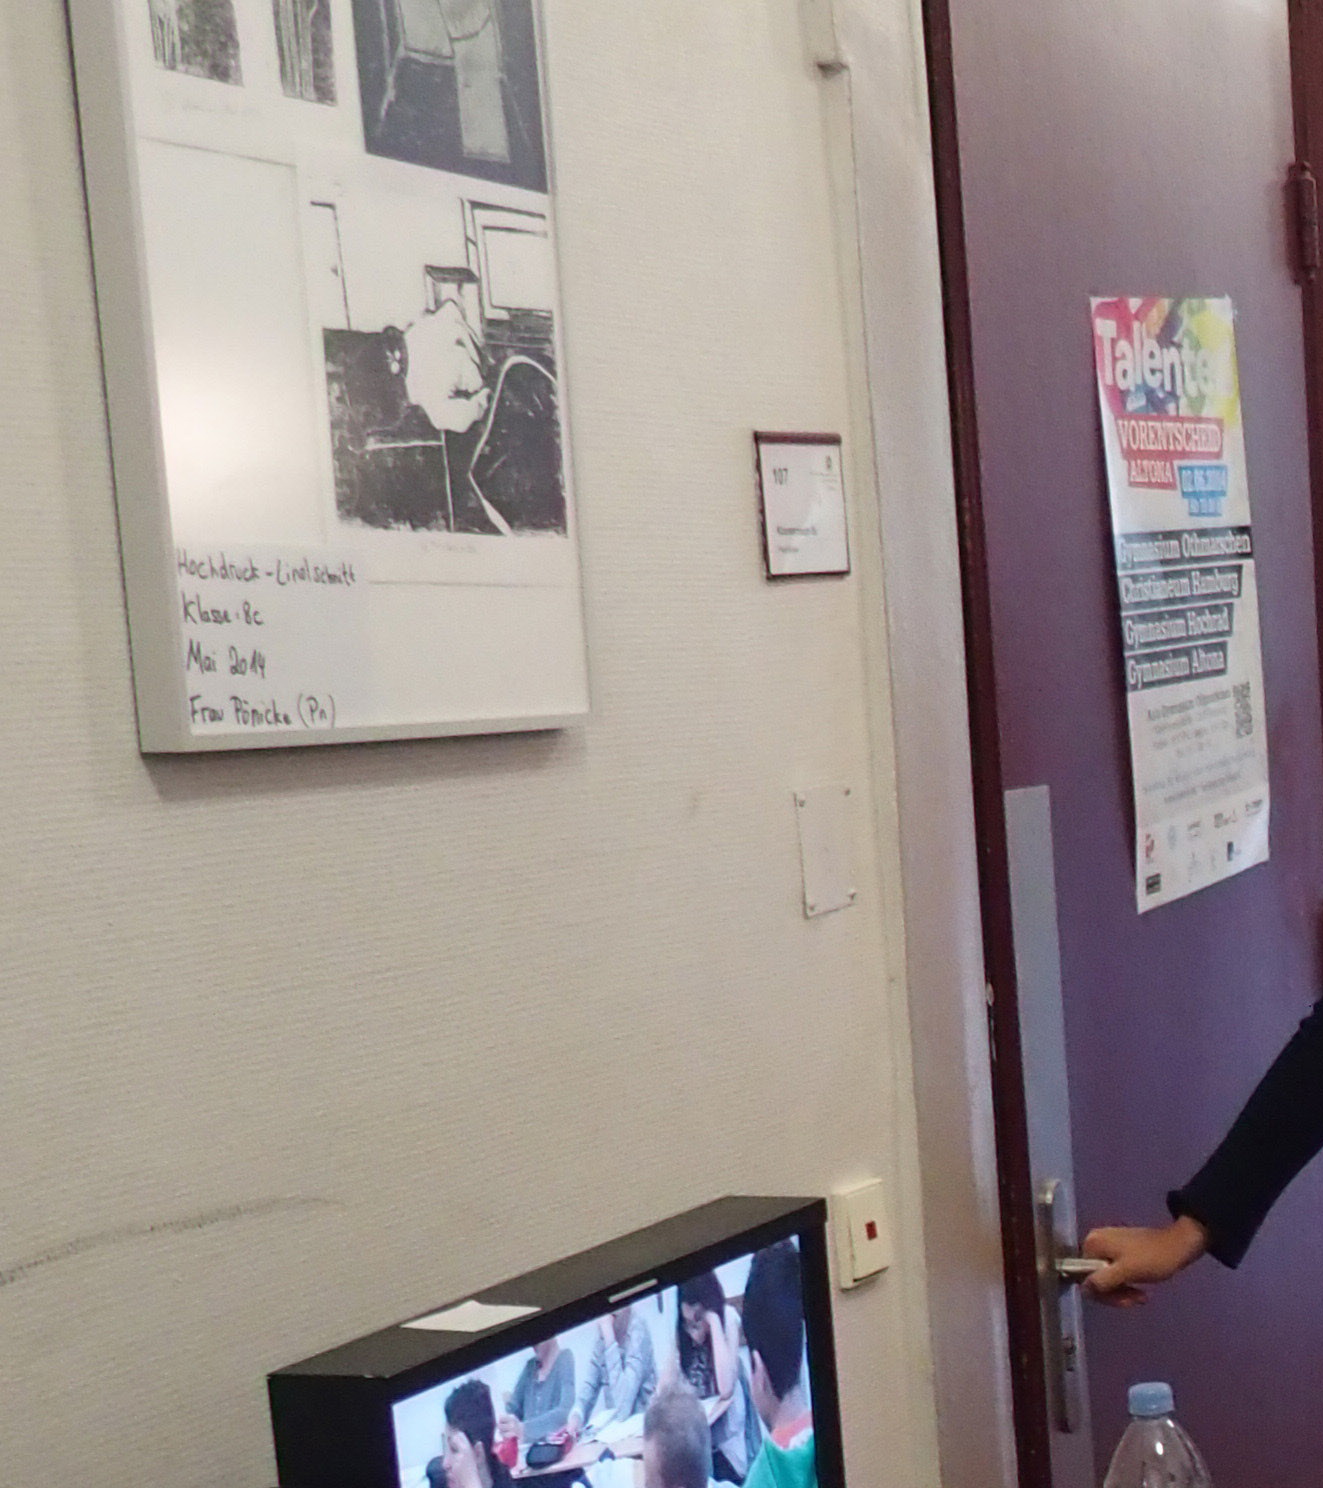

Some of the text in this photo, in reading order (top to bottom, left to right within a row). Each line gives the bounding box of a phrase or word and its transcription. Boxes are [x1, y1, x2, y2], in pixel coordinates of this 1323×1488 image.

[1117, 421, 1222, 452] VORENTSCHEID
[1130, 459, 1173, 483] ALTONA
[178, 550, 260, 582] Hochdruck
[1120, 534, 1181, 568] Gymnasium
[1191, 568, 1239, 596] Hamburg
[1126, 613, 1187, 648] Gymnasium
[186, 638, 266, 679] Mai 2014
[1128, 652, 1190, 689] Gymnasium
[189, 694, 225, 724] Frau
